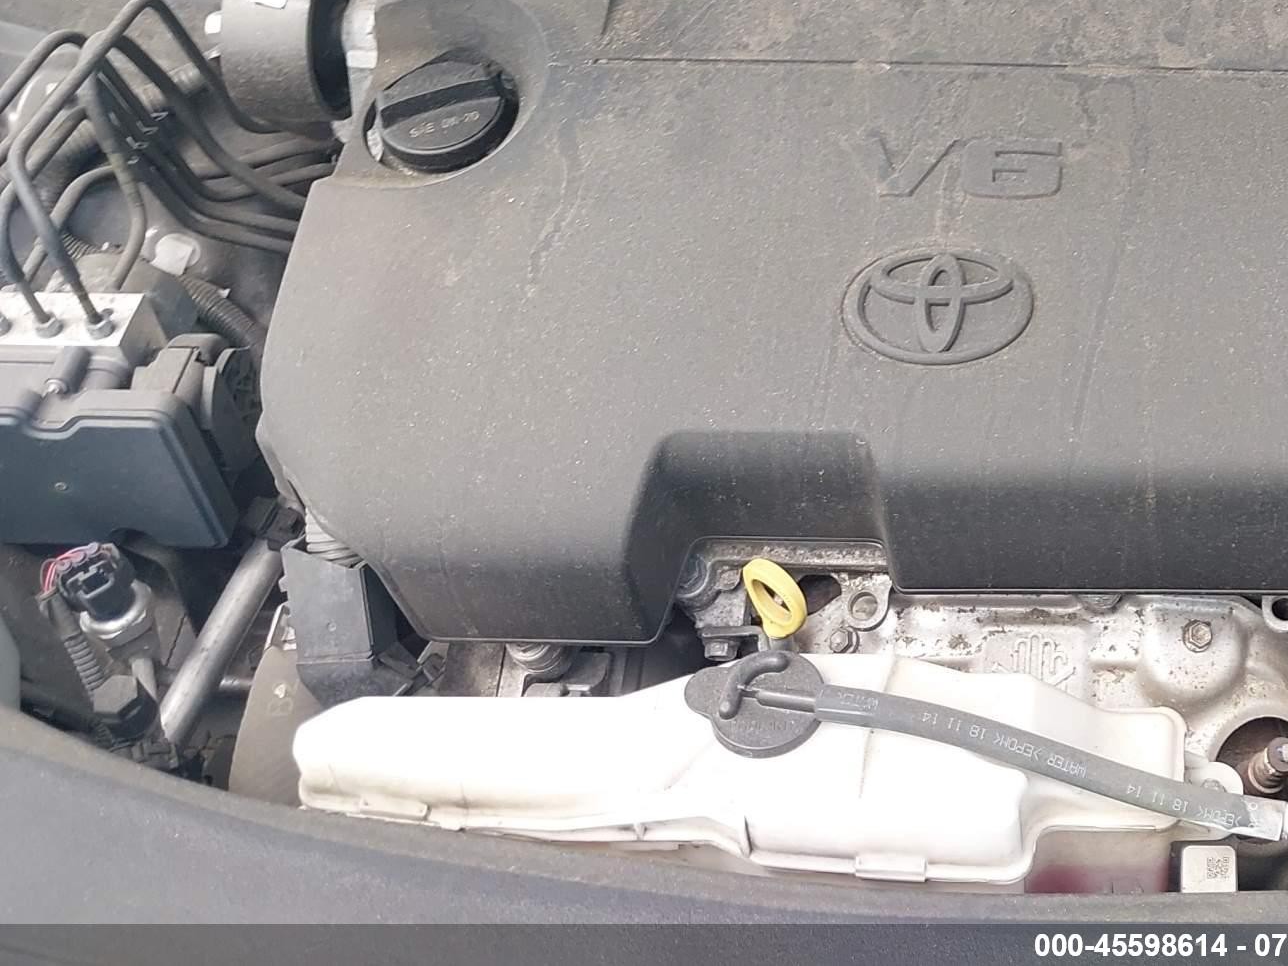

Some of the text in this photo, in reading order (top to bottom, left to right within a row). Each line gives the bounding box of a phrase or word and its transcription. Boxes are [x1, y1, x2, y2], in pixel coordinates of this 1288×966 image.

[858, 128, 1063, 198] V6
[922, 711, 938, 725] 14
[969, 725, 987, 740] 18
[1047, 754, 1087, 778] WATER
[1126, 784, 1142, 798] 14
[1172, 798, 1188, 813] 18
